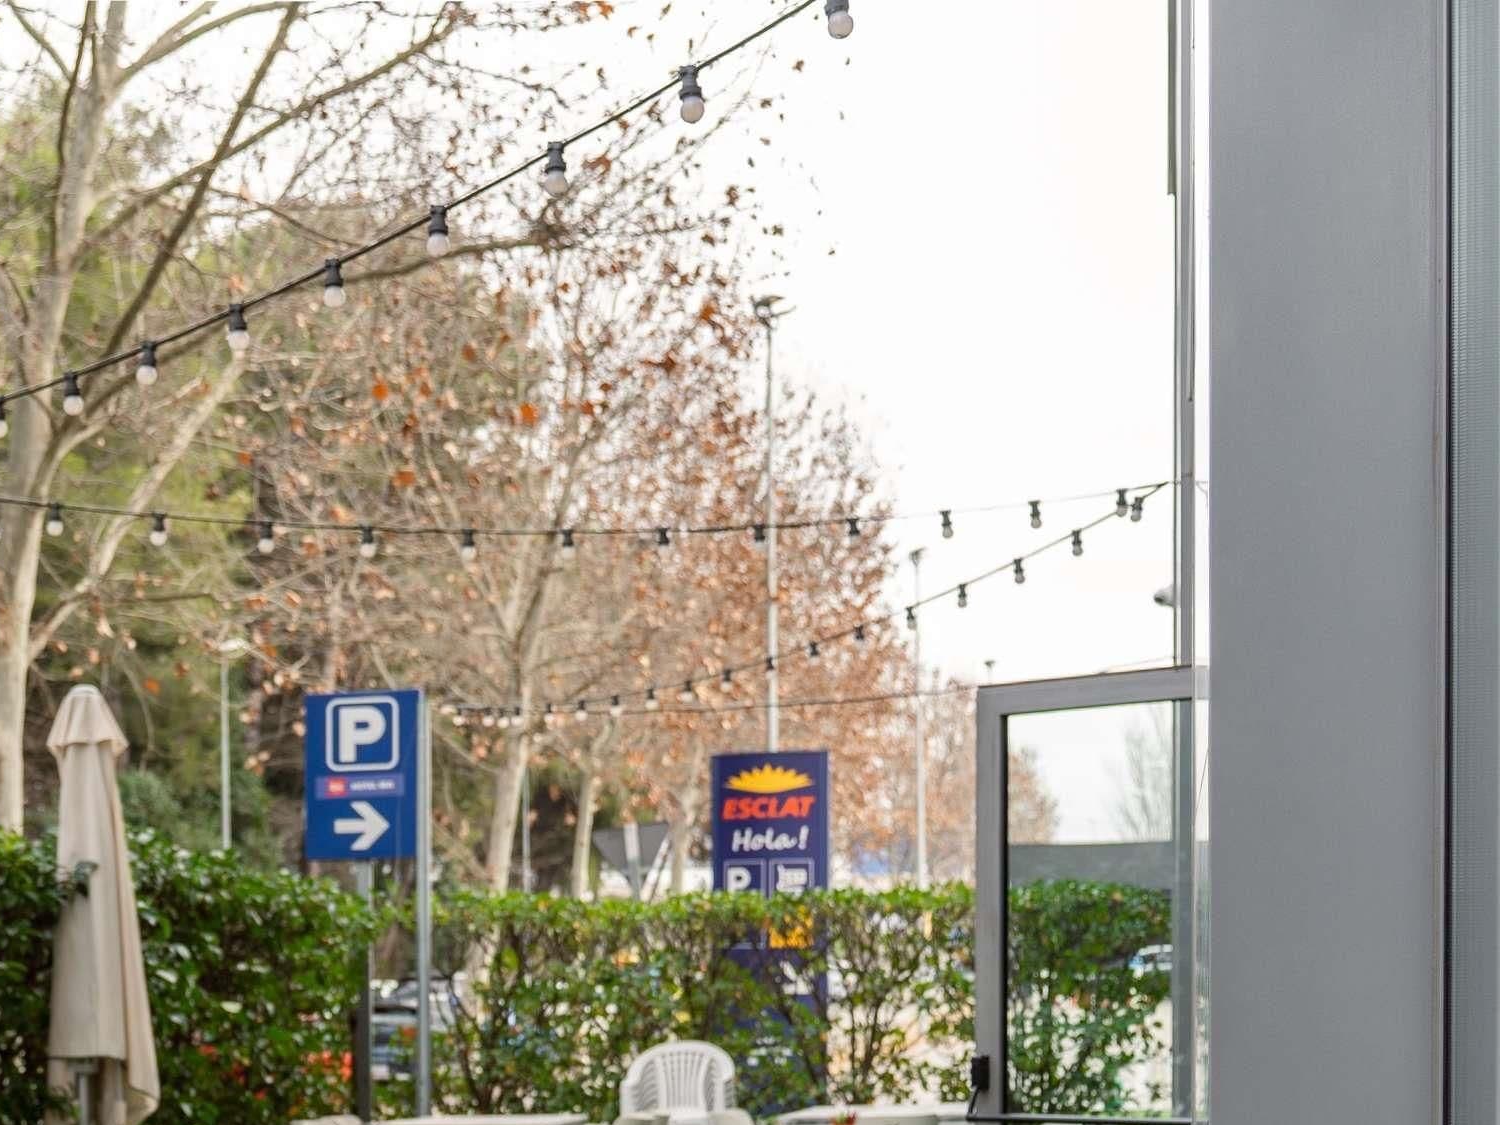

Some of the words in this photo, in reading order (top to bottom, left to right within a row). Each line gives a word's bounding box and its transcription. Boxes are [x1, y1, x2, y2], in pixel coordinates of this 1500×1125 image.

[338, 705, 386, 763] P
[722, 796, 816, 820] ESCLAT
[731, 825, 810, 853] Hola!
